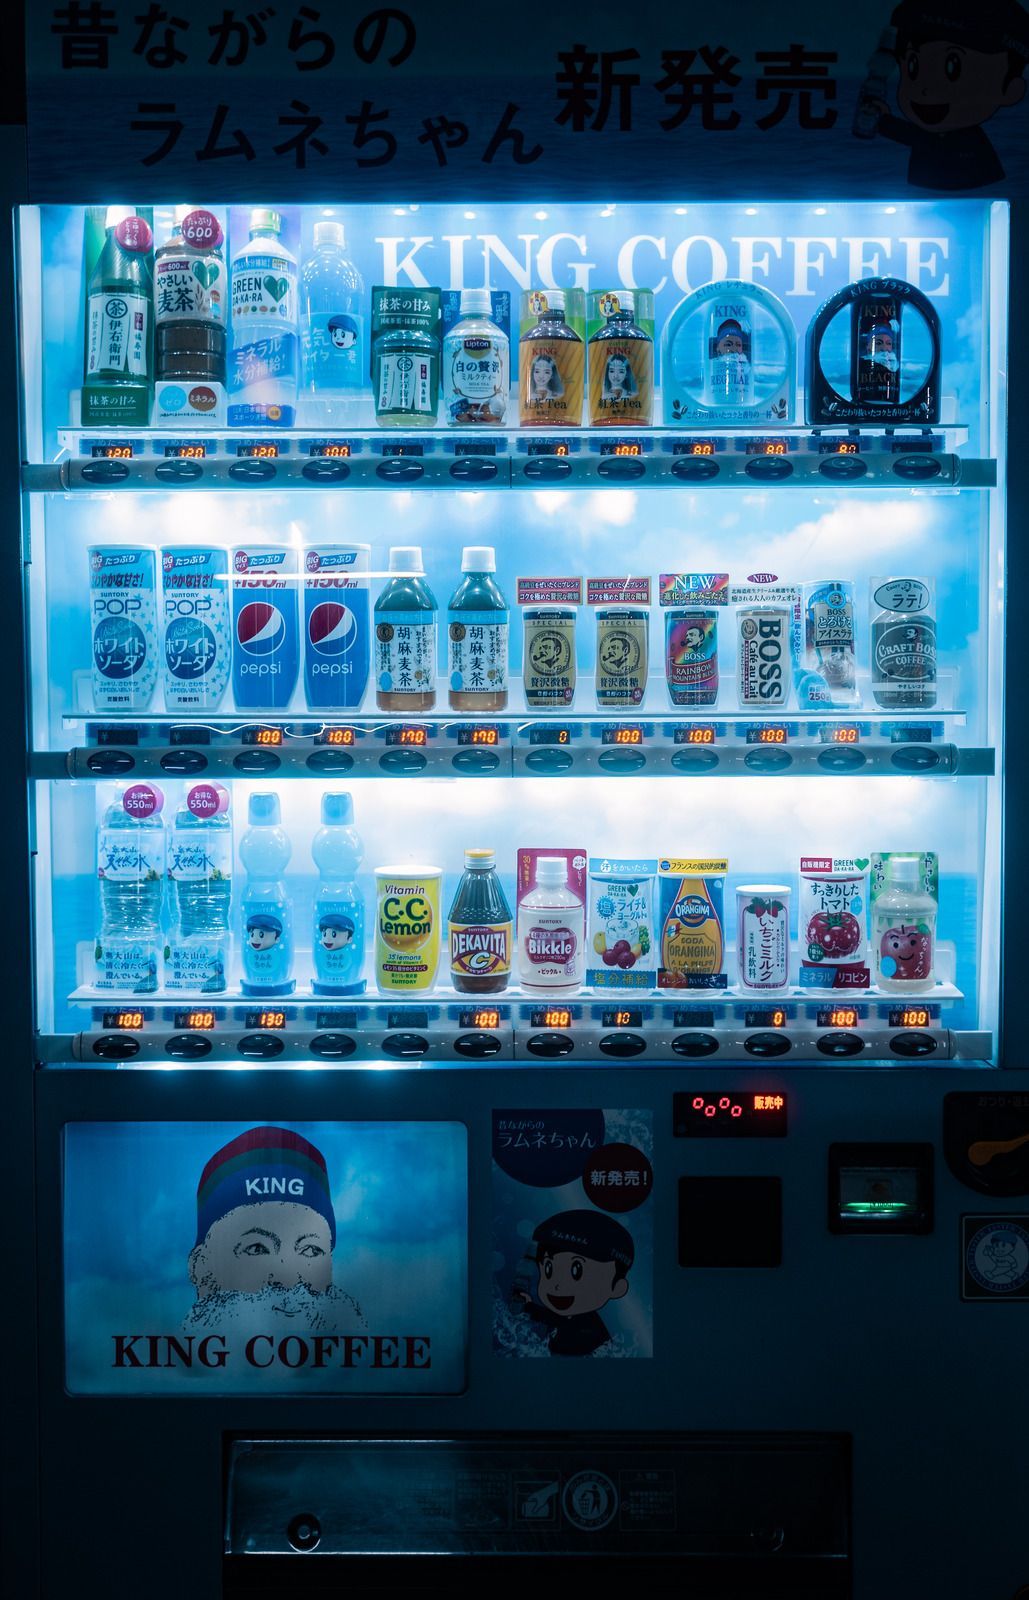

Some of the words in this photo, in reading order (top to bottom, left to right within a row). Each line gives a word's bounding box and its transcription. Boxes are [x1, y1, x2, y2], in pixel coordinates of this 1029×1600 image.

[51, 2, 416, 71] 昔ながらの
[554, 44, 838, 131] 新発売
[130, 101, 543, 168] ラムネちゃん
[187, 227, 213, 239] 600
[375, 233, 596, 291] KING
[618, 233, 949, 298] COFFEE
[157, 274, 193, 288] やさしい
[233, 276, 262, 295] GREEN
[695, 282, 721, 299] KING
[850, 281, 877, 297] KING
[882, 281, 911, 294] ブラック
[158, 288, 194, 315] 麦茶
[379, 298, 431, 312] 抹茶の甘み
[715, 305, 746, 318] KING
[864, 305, 897, 318] KING
[109, 320, 122, 366] 伊右衛門
[235, 339, 282, 366] ミネラル
[532, 348, 557, 356] KING
[606, 347, 631, 356] KING
[456, 361, 500, 373] 白の贅沢
[861, 373, 897, 383] BLACK
[89, 395, 136, 407] 抹茶の甘み
[190, 394, 215, 403] ミネラル
[546, 398, 567, 409] Tea
[621, 398, 642, 409] Tea
[107, 446, 132, 458] 120
[180, 446, 204, 458] 120
[253, 446, 277, 458] 120
[325, 446, 349, 457] 100
[616, 445, 639, 456] 100
[105, 554, 136, 566] たっぷり
[175, 554, 206, 566] たっぷり
[236, 555, 247, 564] BIG
[250, 555, 280, 565] たっぷり
[308, 555, 318, 564] BIG
[322, 555, 352, 565] たっぷり
[674, 575, 715, 590] NEW
[752, 574, 774, 583] NEW
[94, 599, 142, 615] POP
[165, 599, 212, 616] POP
[893, 593, 922, 609] ラテ!
[827, 608, 846, 616] BOSS
[94, 638, 144, 654] ホワイト
[166, 637, 215, 654] ホワイト
[749, 640, 758, 663] Café
[879, 643, 915, 657] CRAFT
[99, 653, 144, 671] ソーダ
[170, 653, 214, 671] ソーダ
[397, 626, 412, 687] 胡麻麦茶
[470, 626, 484, 687] 胡麻麦茶
[685, 652, 706, 661] BOSS
[759, 618, 782, 699] BOSS
[896, 656, 926, 665] COFFEE
[240, 661, 281, 677] pepsi
[312, 661, 352, 677] pepsi
[676, 664, 711, 675] RAINBOW
[749, 665, 758, 678] au
[531, 677, 569, 688] 贅沢微糖
[601, 677, 639, 688] 贅沢微糖
[749, 680, 758, 699] Lait
[257, 730, 280, 743] 100
[328, 730, 351, 743] 100
[558, 731, 567, 743] 0
[616, 730, 639, 742] 100
[688, 729, 712, 742] 100
[760, 729, 784, 742] 100
[833, 729, 856, 742] 100
[194, 791, 211, 799] お得な
[127, 800, 153, 810] 550ml
[190, 800, 216, 810] 550ml
[104, 853, 151, 872] 天然水
[172, 853, 216, 872] 天然水
[601, 862, 648, 872] 汗をかいたら
[801, 860, 831, 870] 自販機限定
[834, 859, 854, 867] GREEN
[873, 862, 885, 889] 味わい
[924, 857, 934, 892] やさしい
[385, 884, 425, 895] Vitamin
[608, 884, 626, 893] GREEN
[811, 883, 859, 897] すっきりした
[384, 897, 428, 921] C.C.
[600, 901, 612, 917] 塩
[820, 897, 850, 910] トマト
[675, 905, 710, 917] ORANGINA
[380, 918, 431, 936] Lemon
[453, 931, 506, 961] DEKAVITA
[529, 939, 572, 955] Bikkle
[669, 946, 715, 957] ORANGINA
[759, 917, 775, 982] いちごミルク
[470, 951, 490, 969] C
[748, 946, 757, 979] 乳飲料
[105, 971, 143, 980] 澄んでいる。
[172, 971, 210, 980] 澄んでいる。
[594, 972, 648, 985] 塩分補給
[801, 972, 831, 982] ミネラル
[839, 973, 867, 983] リコピン
[118, 1013, 142, 1026] 100
[190, 1013, 213, 1026] 100
[260, 1013, 283, 1026] 130
[475, 1013, 497, 1026] 100
[546, 1012, 568, 1025] 100
[617, 1012, 630, 1024] 10
[773, 1012, 782, 1024] 0
[831, 1011, 854, 1025] 100
[903, 1011, 926, 1025] 100
[754, 1095, 784, 1110] 販売中
[498, 1120, 545, 1130] 昔ながらの
[498, 1131, 596, 1149] ラムネちゃん
[590, 1170, 648, 1187] 新発売!
[245, 1177, 305, 1197] KING
[111, 1335, 230, 1368] KING
[245, 1335, 432, 1369] COFFEE
